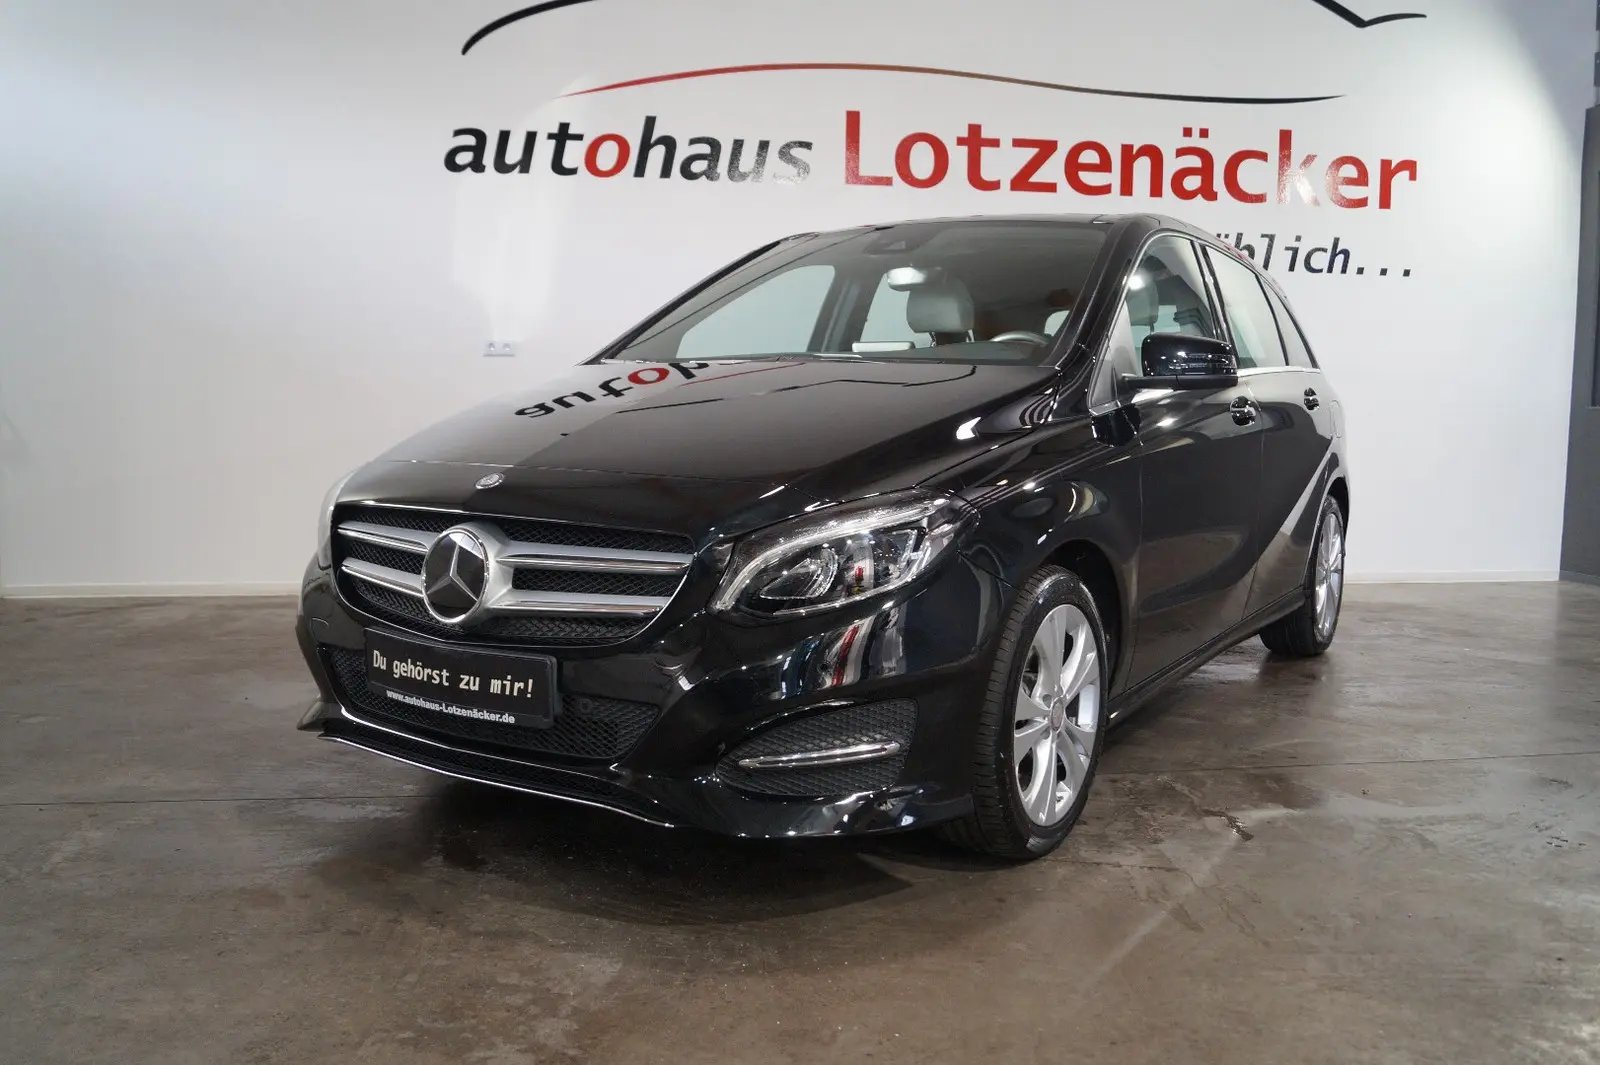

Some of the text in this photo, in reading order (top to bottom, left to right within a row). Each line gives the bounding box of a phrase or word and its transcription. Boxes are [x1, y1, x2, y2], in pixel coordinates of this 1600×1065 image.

[444, 110, 1418, 210] autohaus Lotzenäcker
[1216, 232, 1411, 277] hlich...
[373, 650, 534, 699] Du gehörst zu mir!
[386, 689, 516, 724] www.autohaus-Lotzenäcker.de
